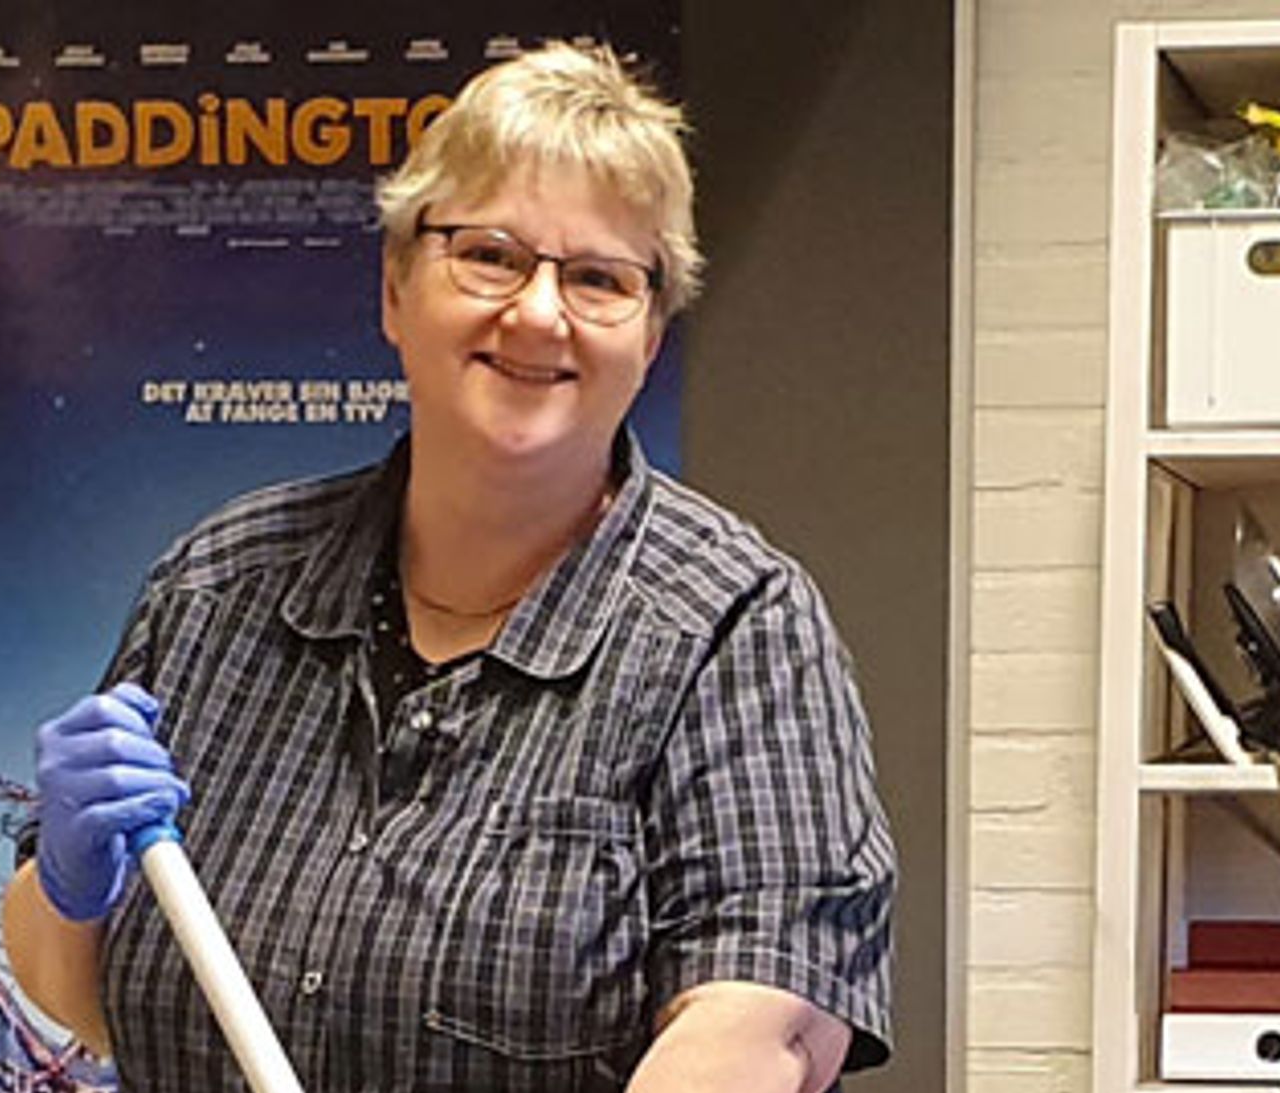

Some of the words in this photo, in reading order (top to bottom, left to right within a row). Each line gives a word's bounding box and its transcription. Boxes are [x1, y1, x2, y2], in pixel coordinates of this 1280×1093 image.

[143, 381, 187, 402] DET
[300, 381, 340, 401] SIN
[185, 403, 215, 423] AT
[222, 403, 299, 423] FANGE
[305, 403, 338, 423] EN
[343, 402, 388, 422] TYV
